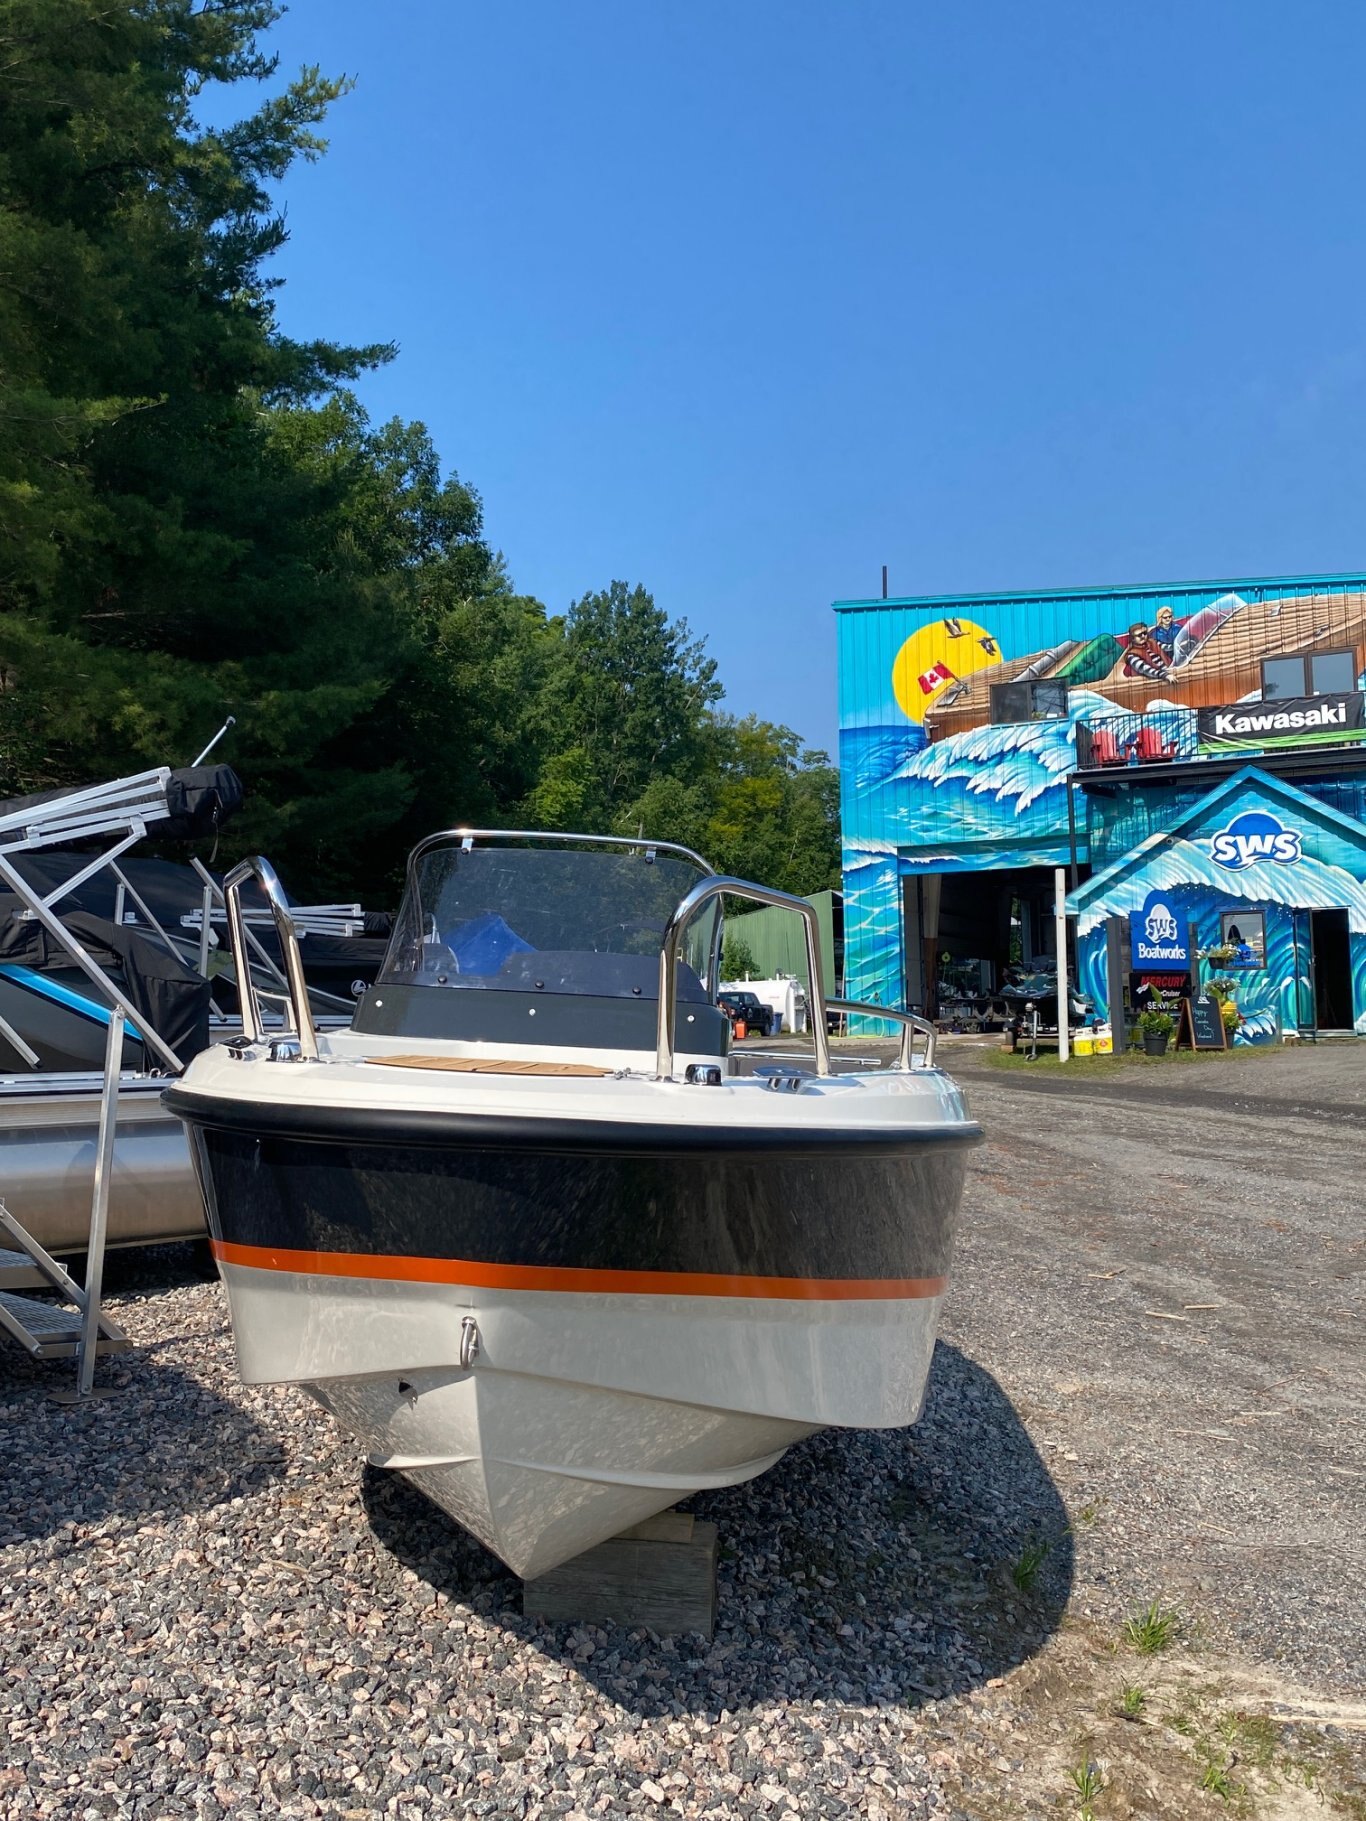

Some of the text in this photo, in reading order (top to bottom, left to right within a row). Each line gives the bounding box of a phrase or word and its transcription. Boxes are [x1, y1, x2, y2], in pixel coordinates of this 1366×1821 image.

[1215, 703, 1347, 735] Kawasaki
[1213, 833, 1298, 863] SWS
[1147, 918, 1177, 939] SWS
[1138, 943, 1187, 960] Boatworks
[1141, 975, 1186, 987] MERCURY
[1147, 1001, 1179, 1010] SEVIE
